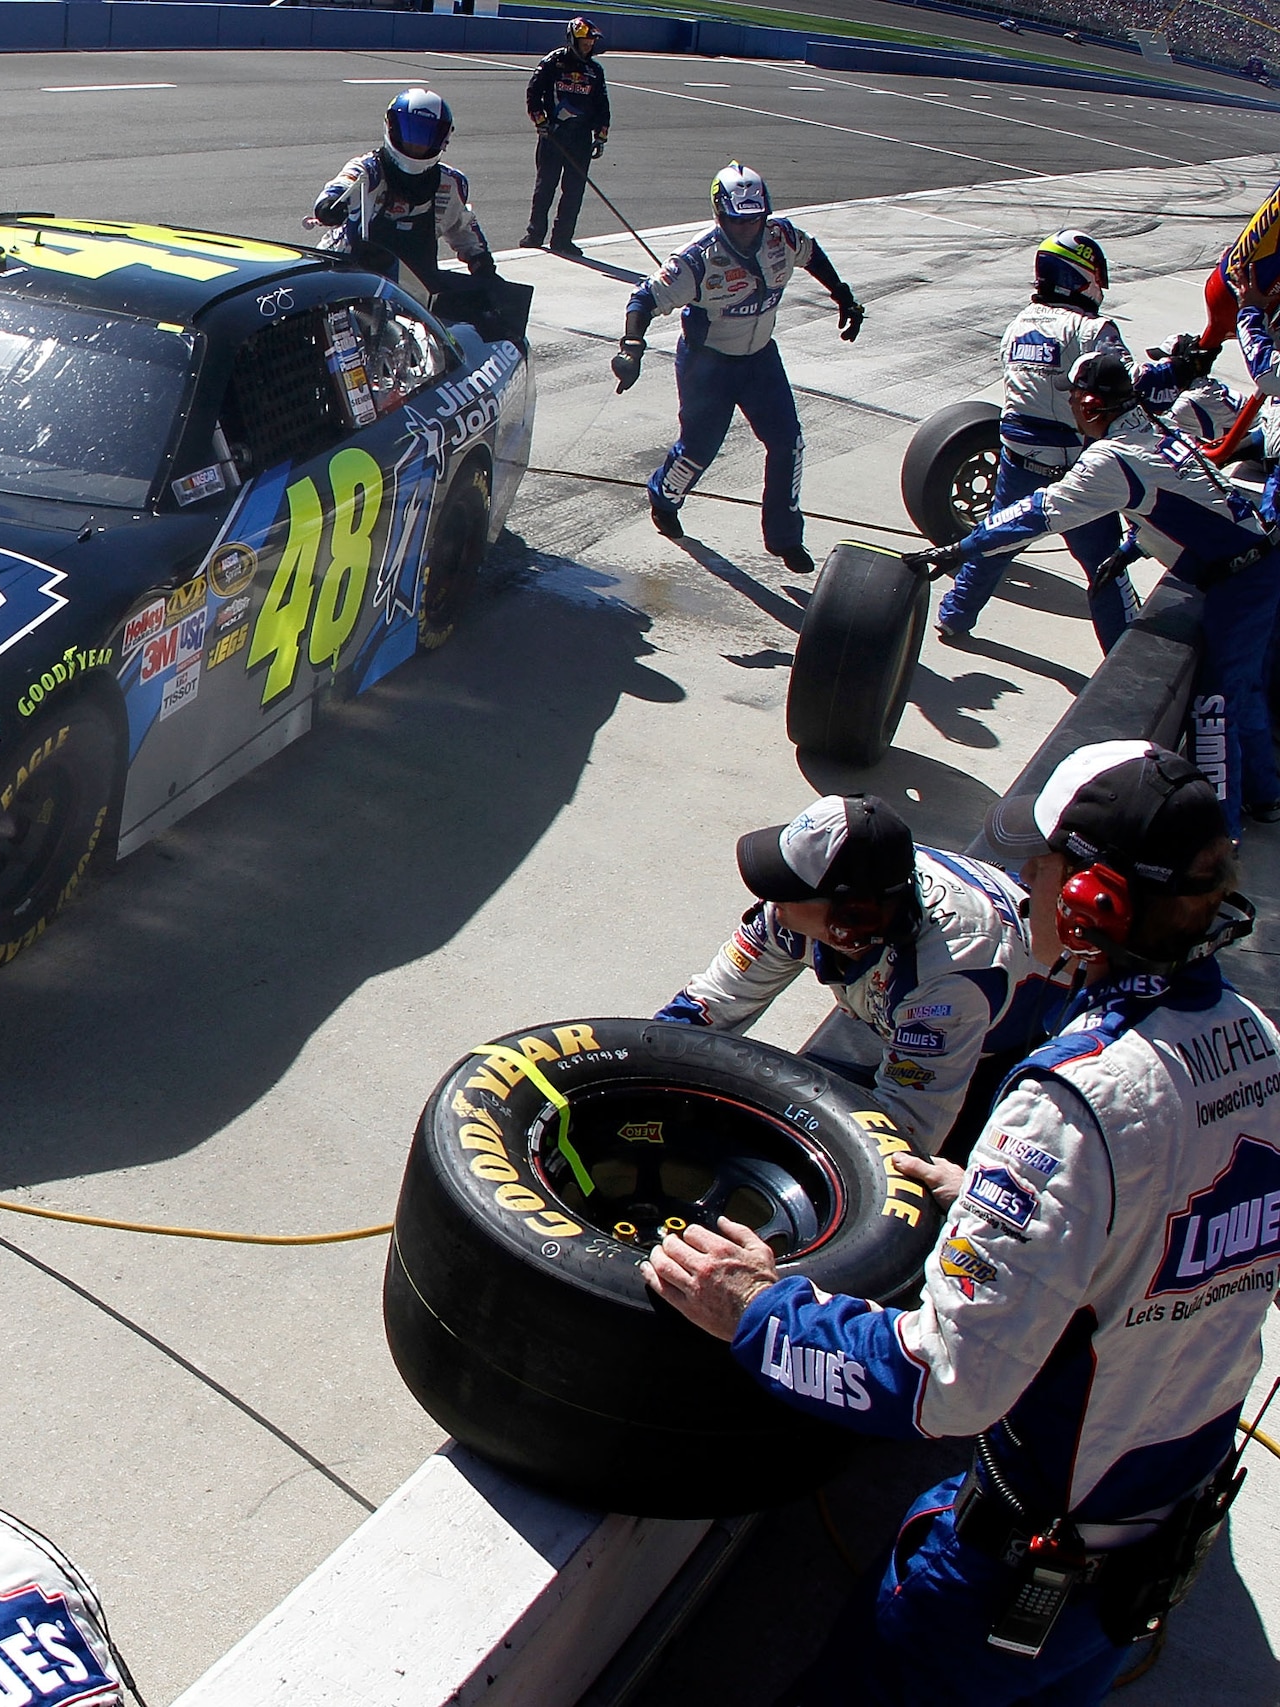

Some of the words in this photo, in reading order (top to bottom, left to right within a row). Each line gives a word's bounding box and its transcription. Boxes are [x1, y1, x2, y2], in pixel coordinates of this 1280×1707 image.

[1075, 243, 1093, 259] 48
[1011, 341, 1055, 363] LOWE'S
[435, 339, 522, 418] Jimmie
[246, 447, 384, 706] 48
[125, 606, 164, 645] Holley
[179, 610, 205, 651] USG
[142, 626, 179, 680] 3M
[207, 623, 250, 671] JEGS
[17, 645, 113, 718] GOODYEAR
[163, 677, 199, 710] TISSOT
[912, 1005, 948, 1019] NASCAR
[896, 1028, 939, 1047] LOWE'S
[1175, 1016, 1276, 1088] MICHEL
[886, 1063, 933, 1081] SUNOCO
[451, 1023, 601, 1238] GOODYEAR
[626, 1127, 658, 1138] AERO
[1001, 1136, 1051, 1174] NASCAR
[973, 1171, 1023, 1216] LOWE'S
[1175, 1189, 1280, 1278] LOWE
[1125, 1302, 1166, 1328] Let's
[761, 1316, 872, 1412] LOWE'S
